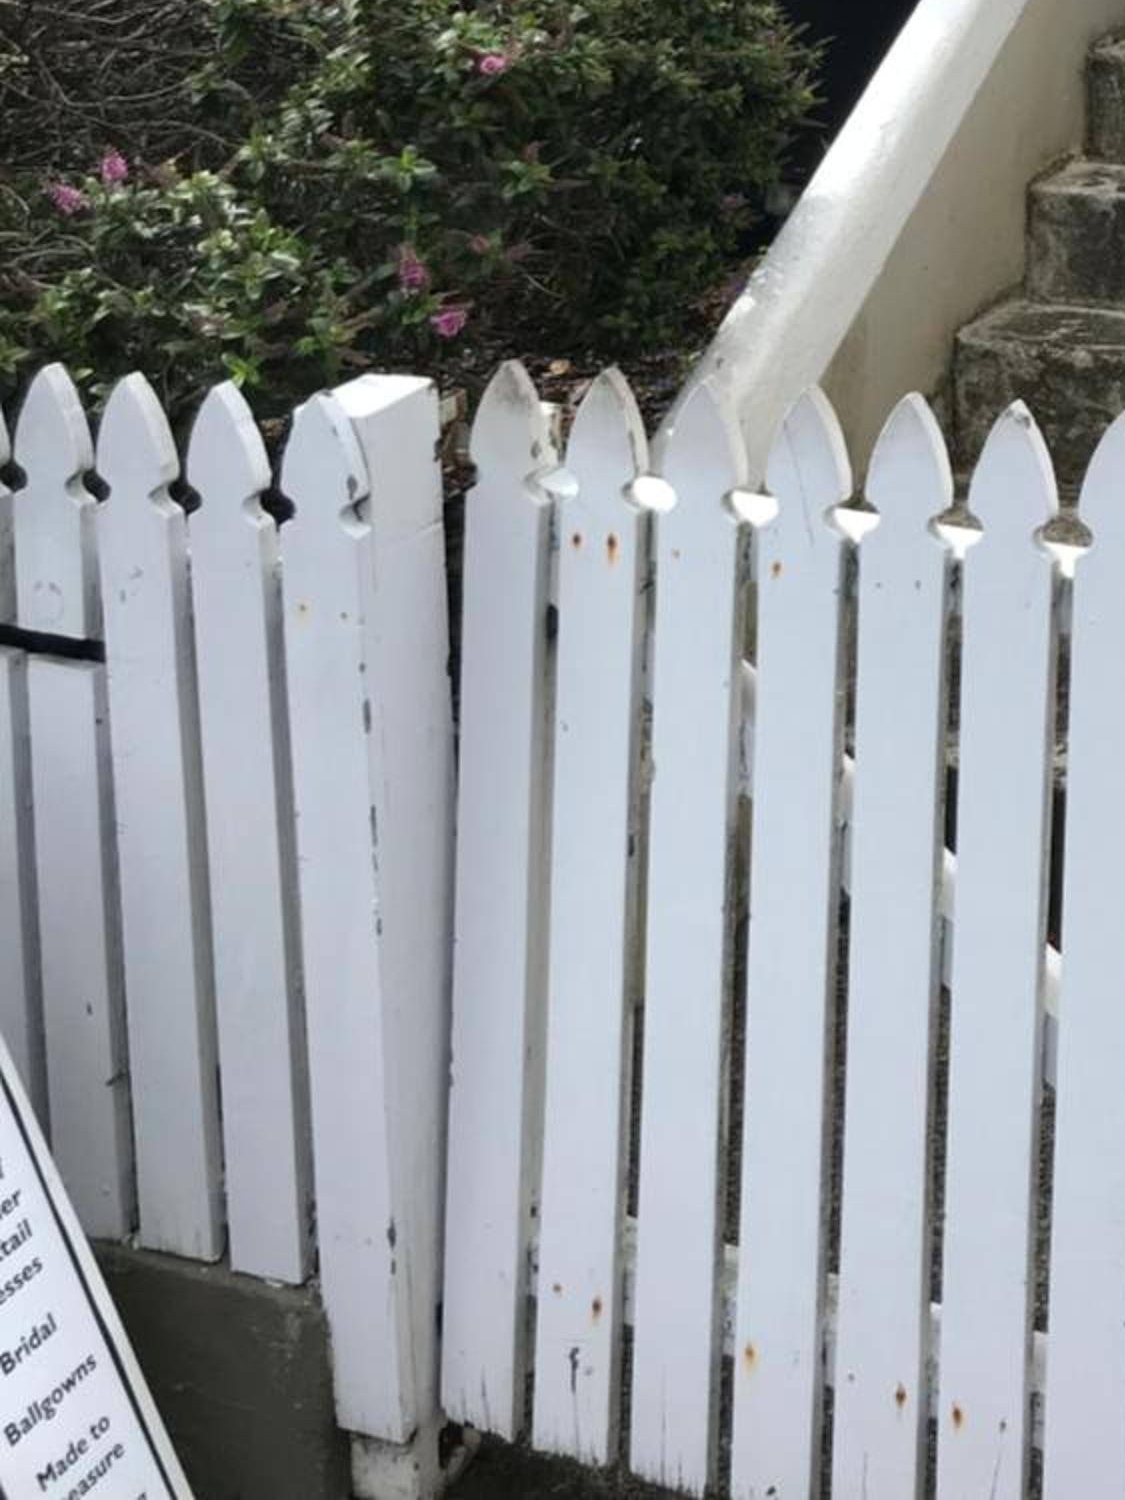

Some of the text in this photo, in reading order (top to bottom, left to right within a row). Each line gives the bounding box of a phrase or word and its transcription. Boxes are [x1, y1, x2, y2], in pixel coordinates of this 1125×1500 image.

[0, 1189, 21, 1220] er
[0, 1218, 33, 1263] tail
[0, 1312, 57, 1376] Bridal
[3, 1354, 97, 1447] Ballgowns
[36, 1416, 110, 1492] Made to
[64, 1442, 125, 1500] easure
